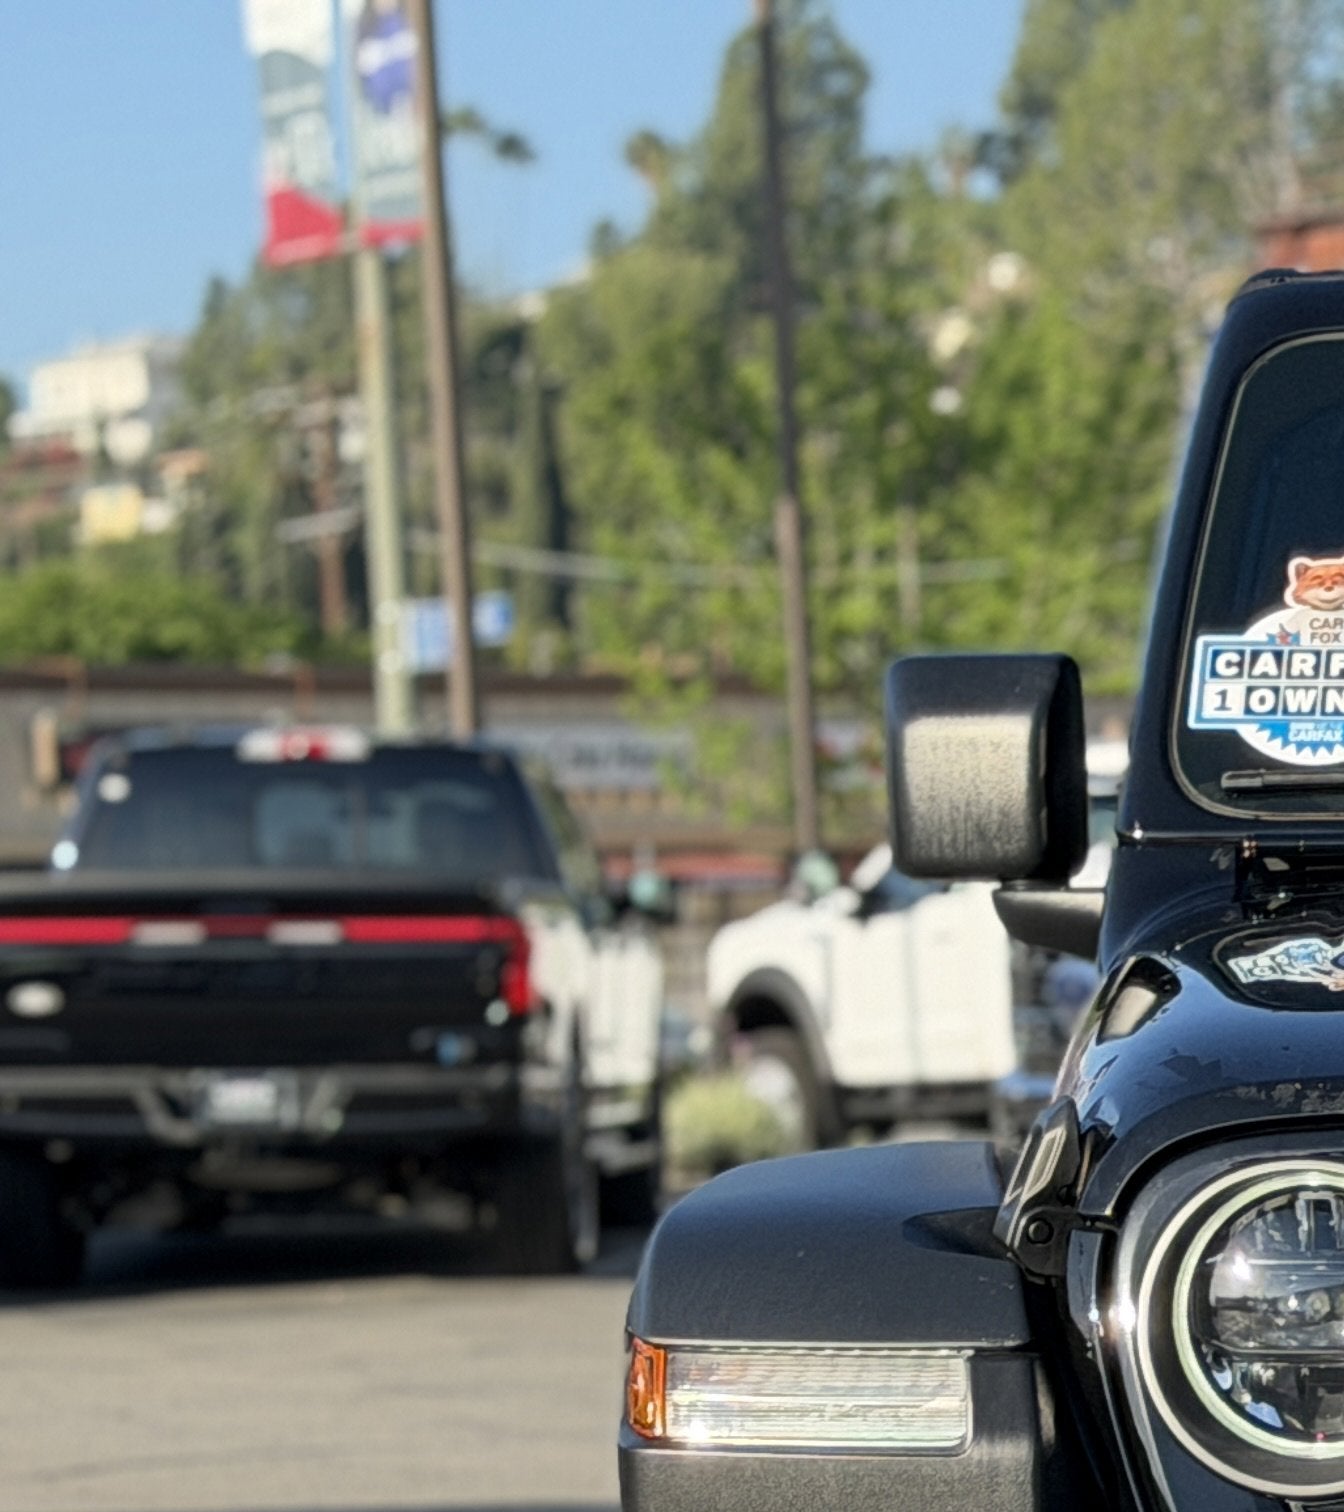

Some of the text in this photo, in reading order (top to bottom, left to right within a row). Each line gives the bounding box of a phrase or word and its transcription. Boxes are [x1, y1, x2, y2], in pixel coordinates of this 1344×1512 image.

[1308, 617, 1344, 631] CAR
[1309, 631, 1342, 644] FOX
[1212, 688, 1233, 712] 1
